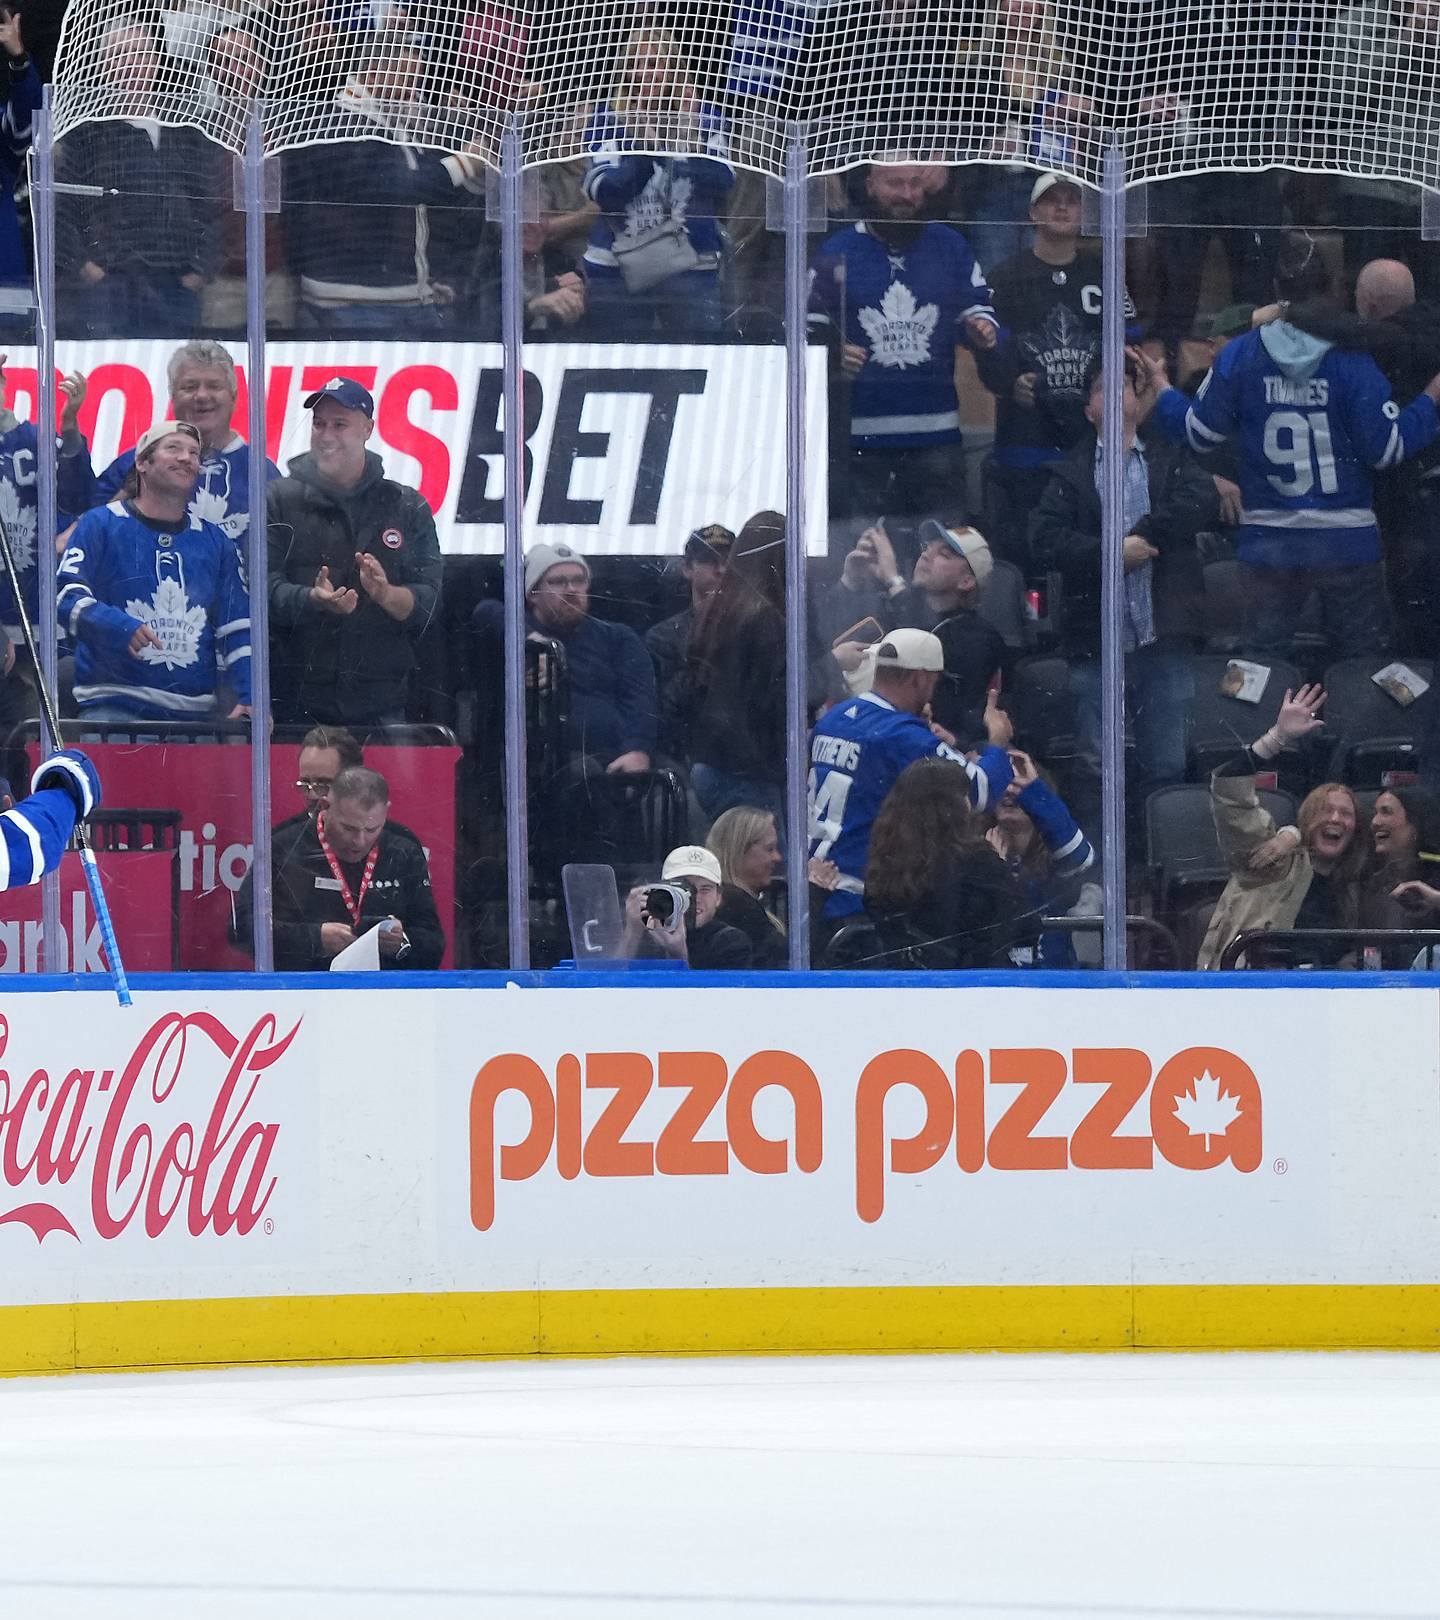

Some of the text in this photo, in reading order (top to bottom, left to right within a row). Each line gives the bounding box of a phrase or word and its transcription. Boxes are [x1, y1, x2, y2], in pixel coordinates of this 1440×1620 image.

[1081, 285, 1102, 315] C
[874, 320, 926, 334] TORONTO
[882, 333, 917, 343] MAPLE
[882, 342, 919, 352] LEAFS
[1036, 348, 1094, 367] TORONTO
[1046, 363, 1087, 376] MAPLE
[1263, 411, 1339, 497] 91
[13, 448, 36, 486] C
